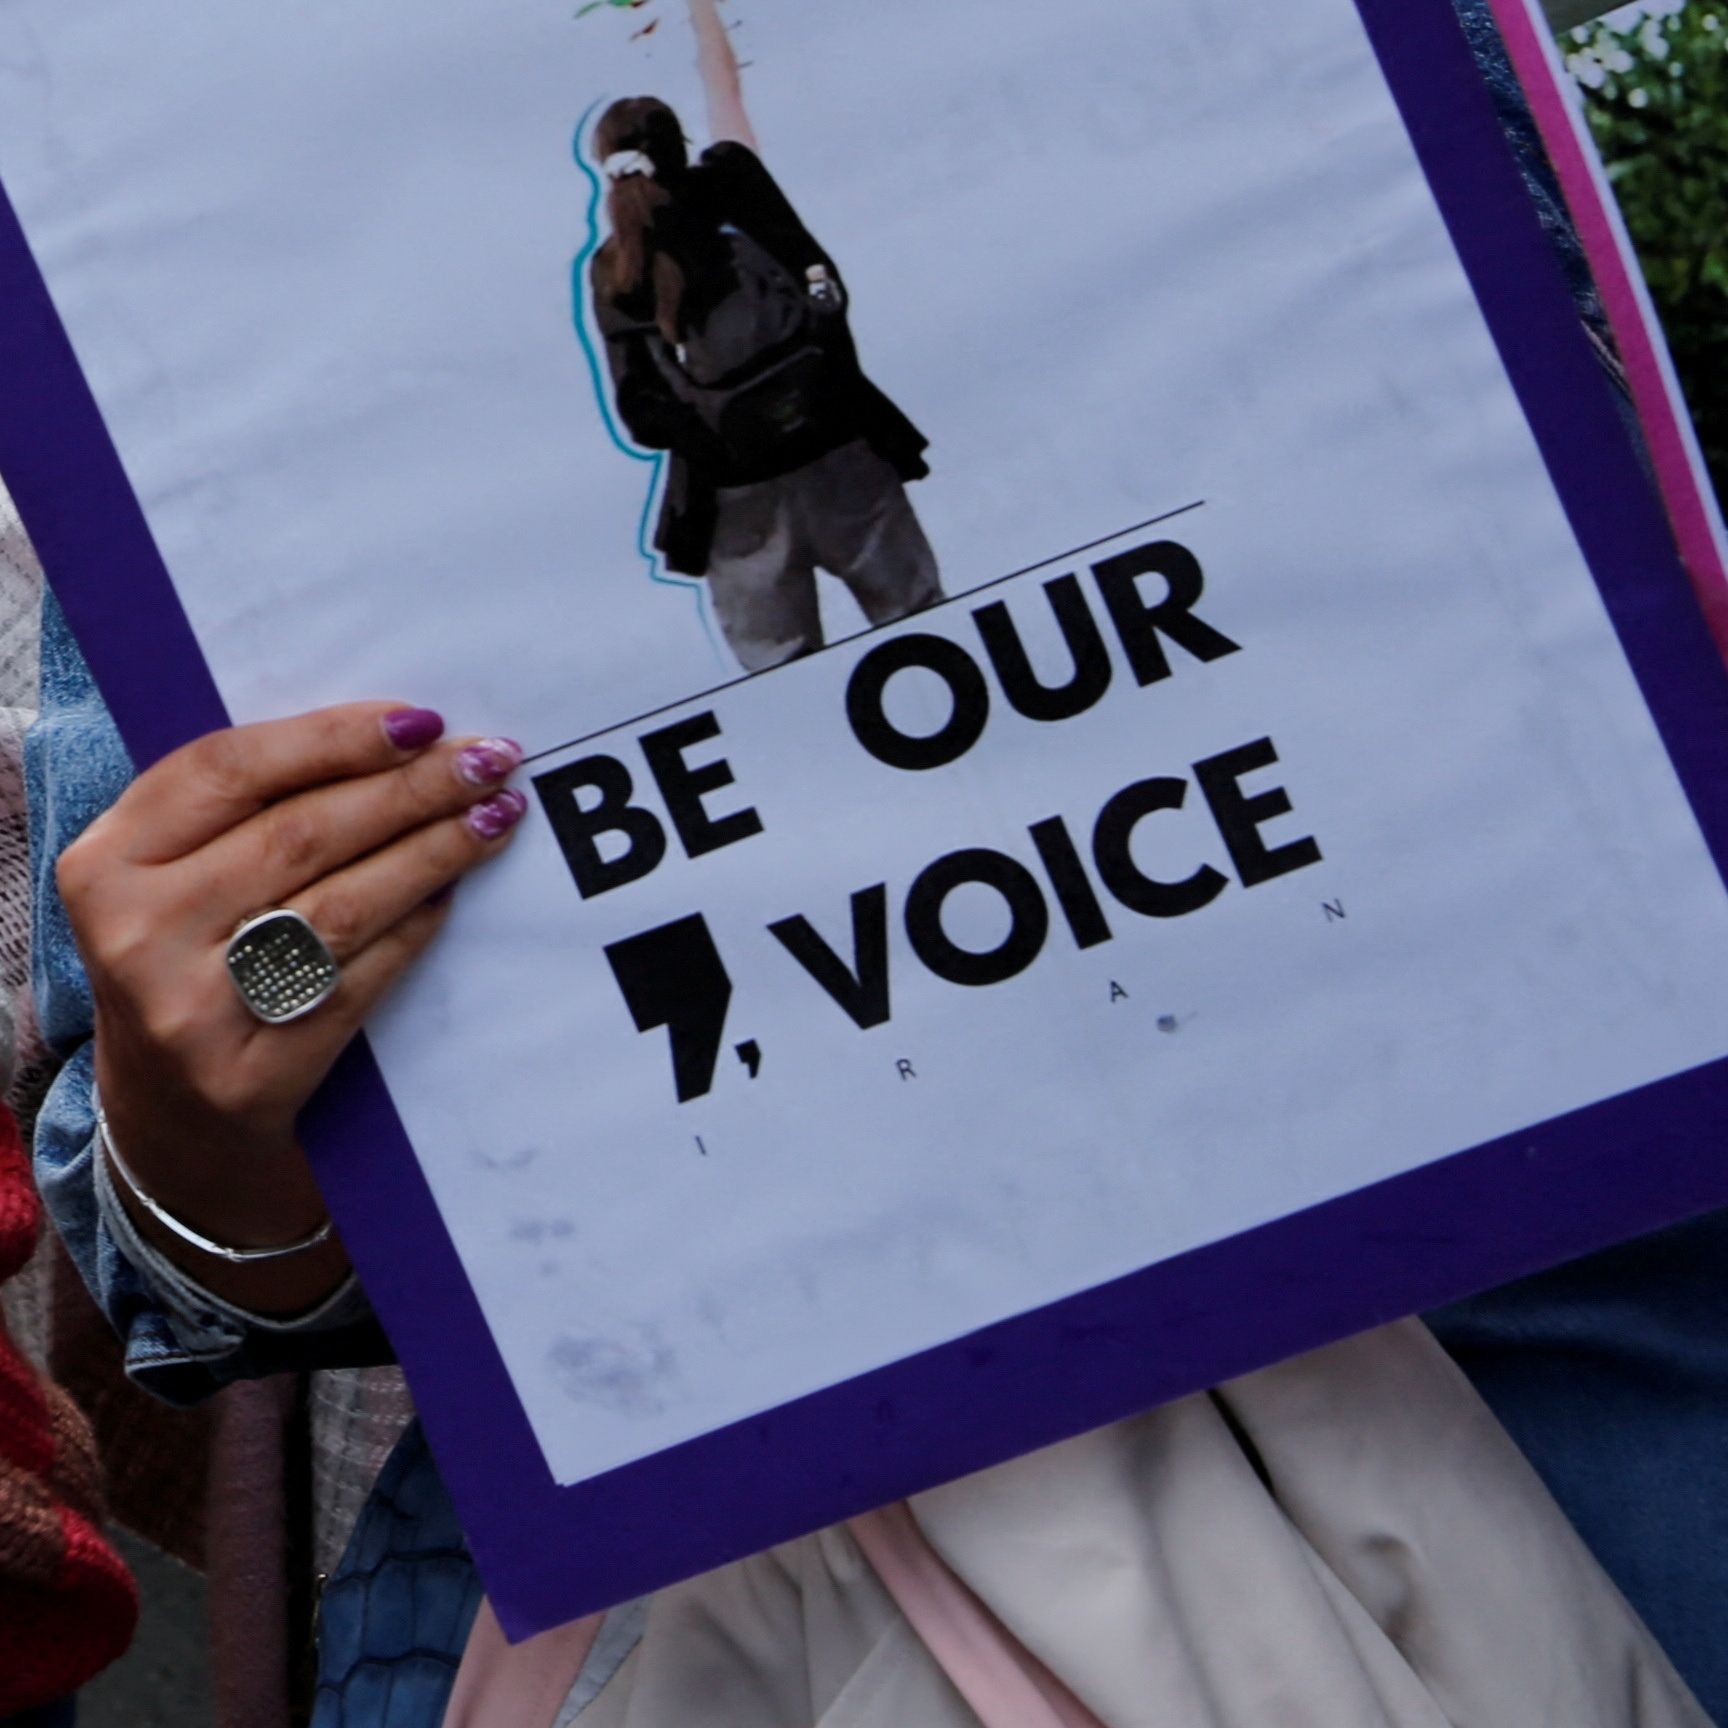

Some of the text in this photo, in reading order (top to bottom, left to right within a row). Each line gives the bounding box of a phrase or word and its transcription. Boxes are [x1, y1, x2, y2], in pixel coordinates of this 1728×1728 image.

[531, 539, 1243, 900] BE OUR
[766, 735, 1324, 1030] VOICE
